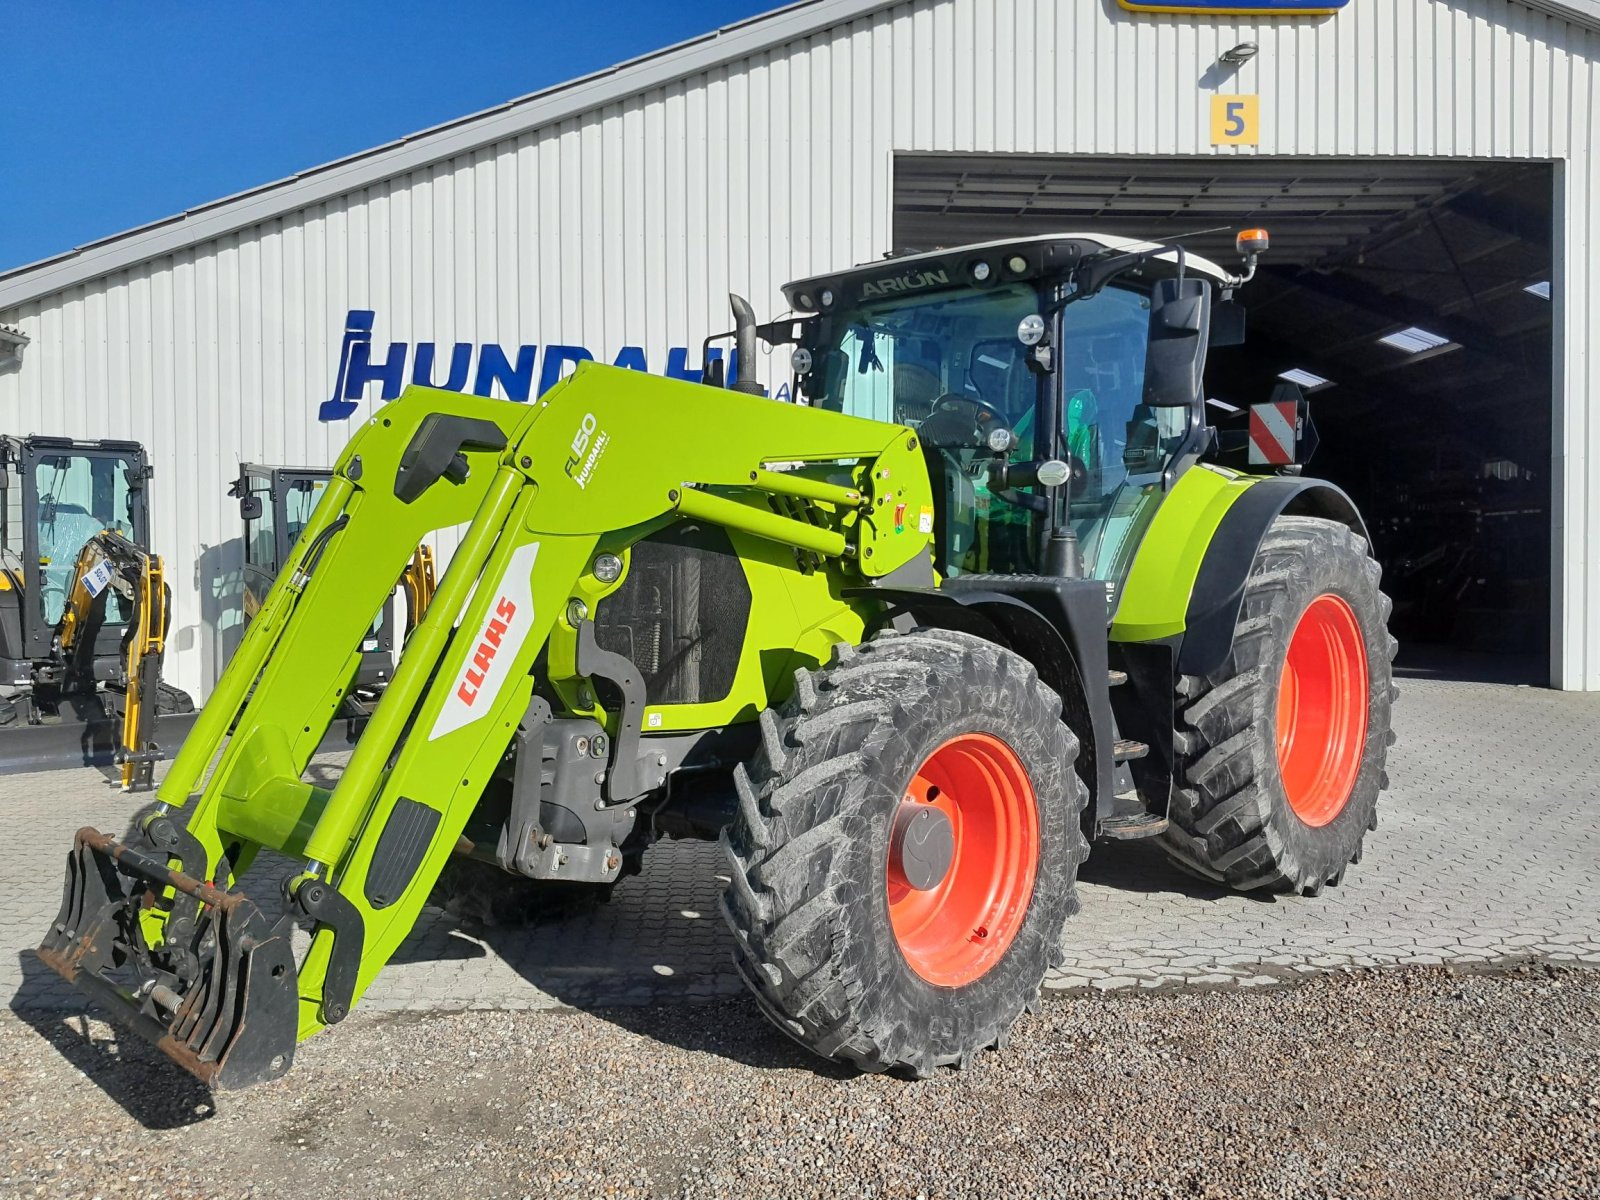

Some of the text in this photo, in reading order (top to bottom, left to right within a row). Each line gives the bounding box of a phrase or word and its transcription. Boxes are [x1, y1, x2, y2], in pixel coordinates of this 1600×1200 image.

[1225, 102, 1245, 136] 5
[863, 270, 949, 297] ARION
[457, 596, 516, 707] CLAAS
